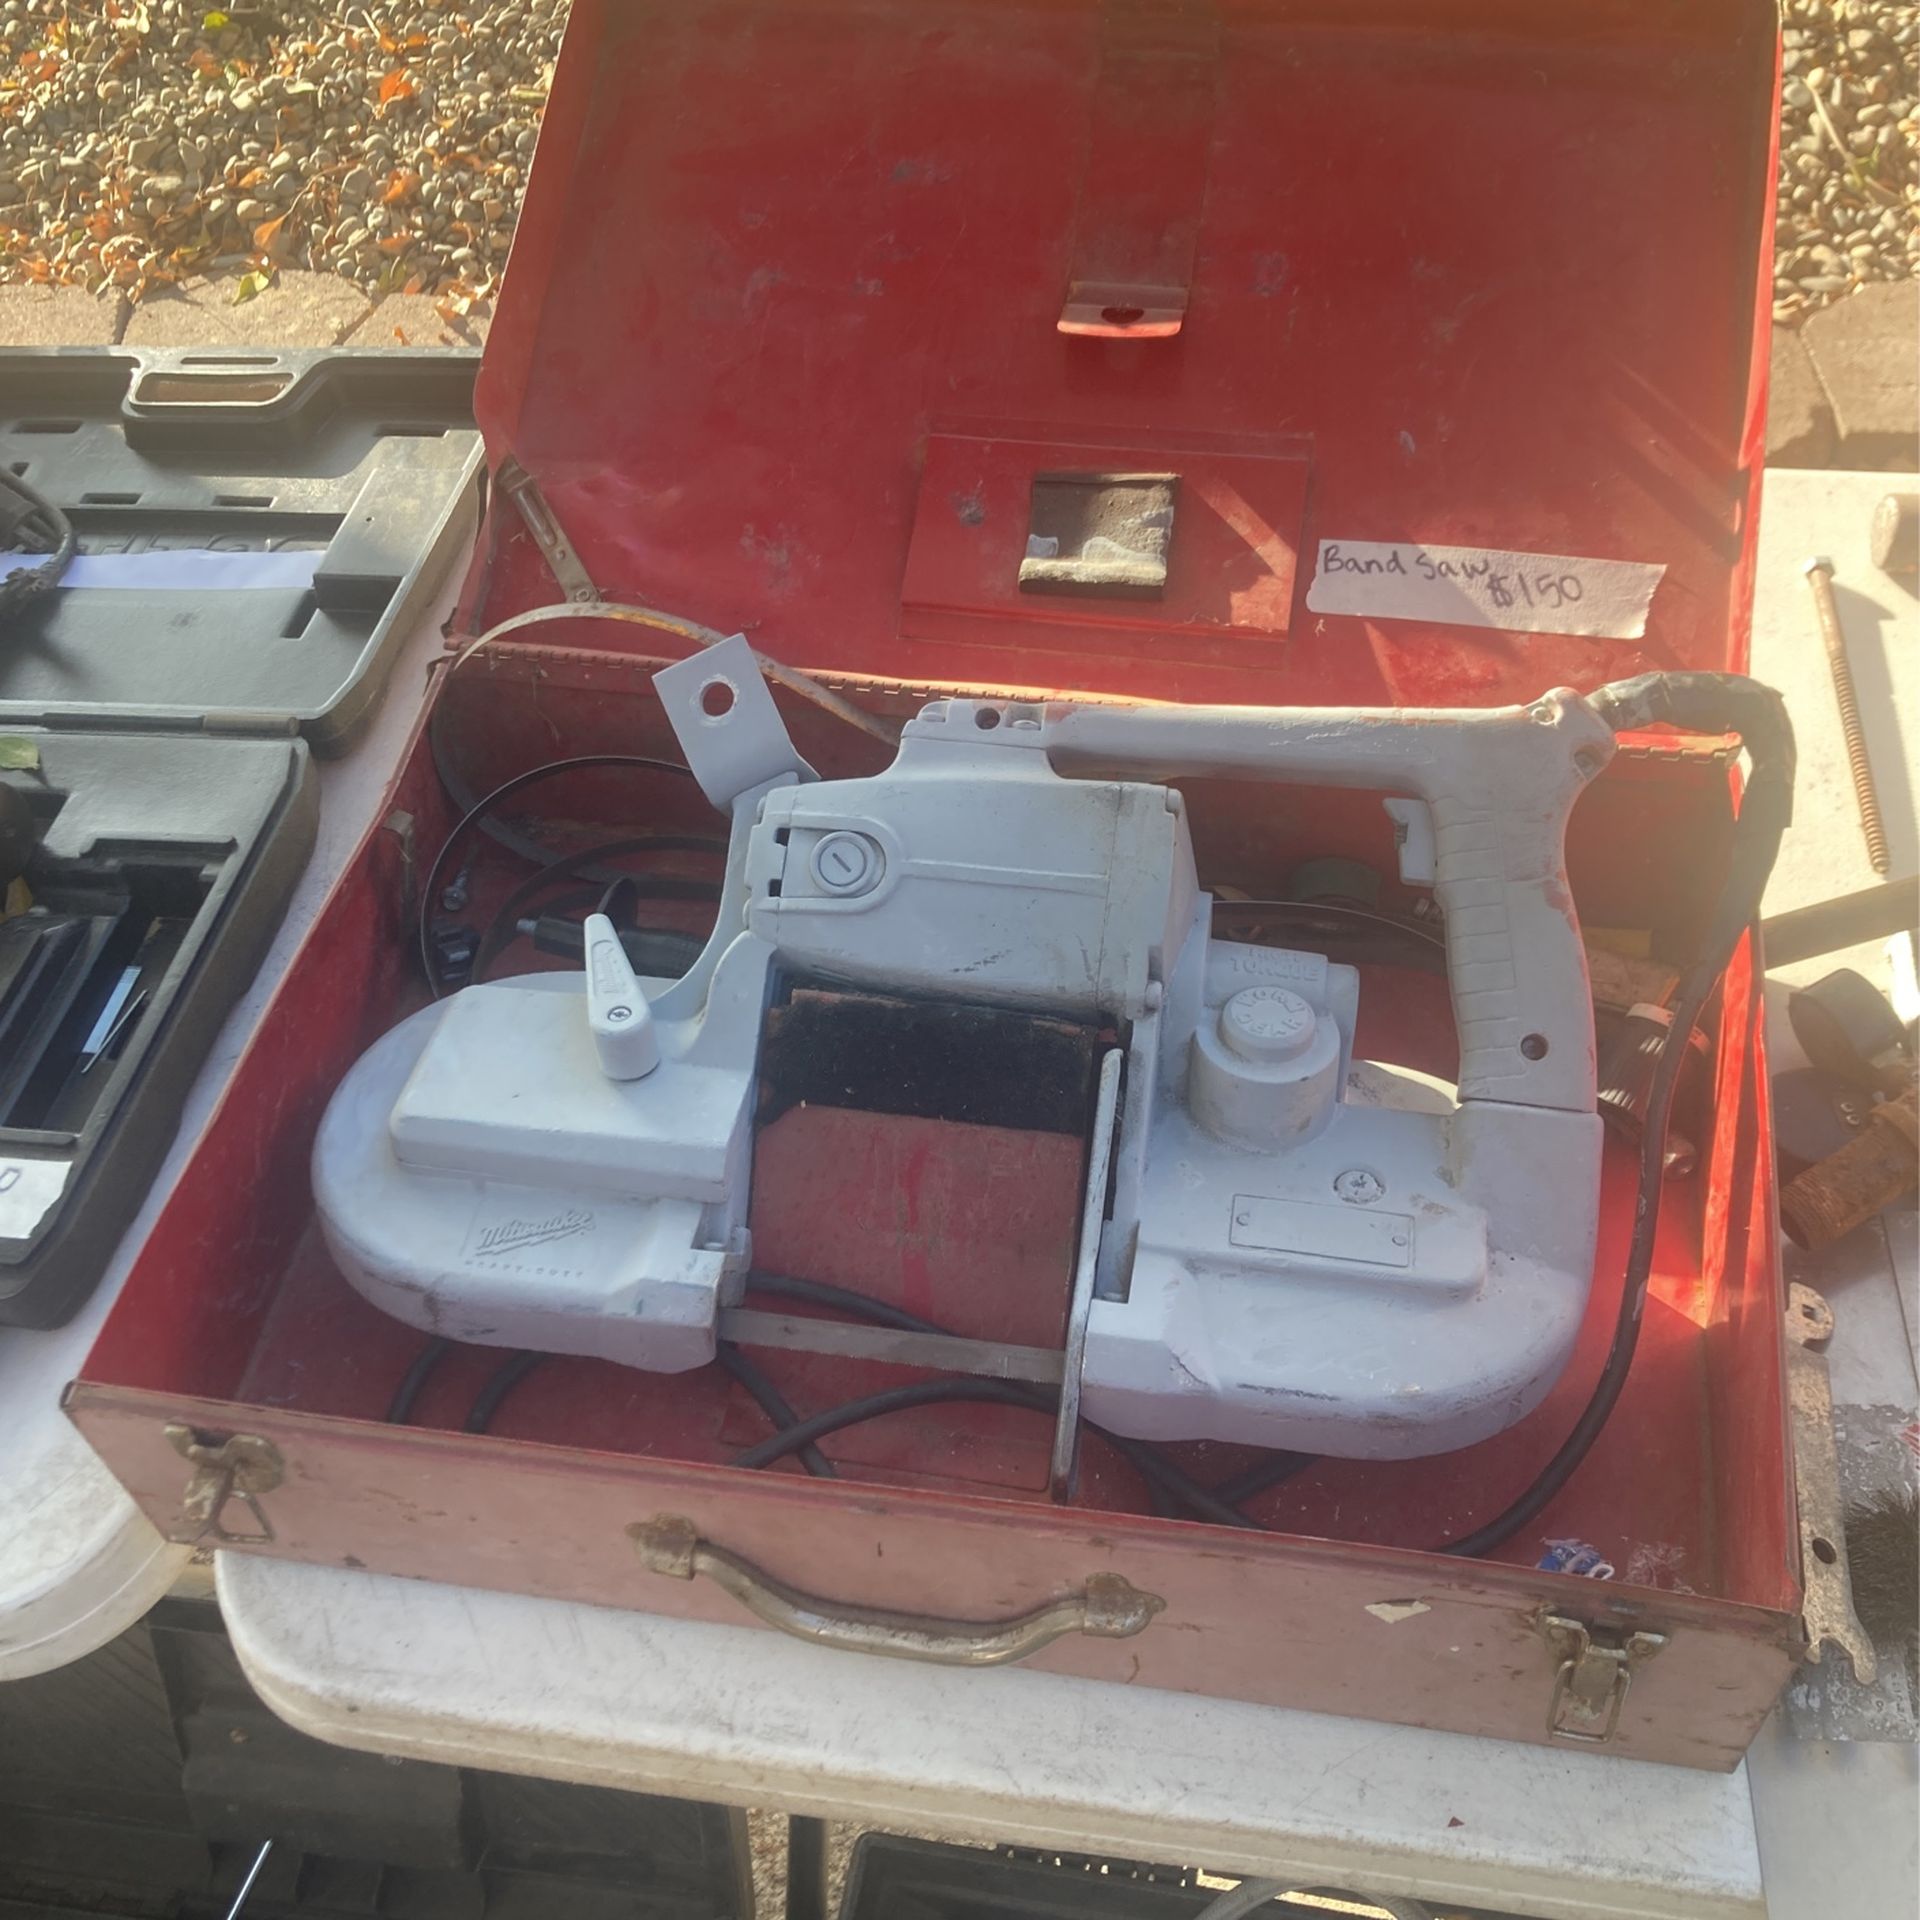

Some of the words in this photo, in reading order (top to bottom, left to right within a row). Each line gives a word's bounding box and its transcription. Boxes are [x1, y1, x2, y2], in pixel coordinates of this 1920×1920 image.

[1323, 546, 1407, 577] Band
[1416, 553, 1490, 580] Saw
[1489, 574, 1582, 609] $150
